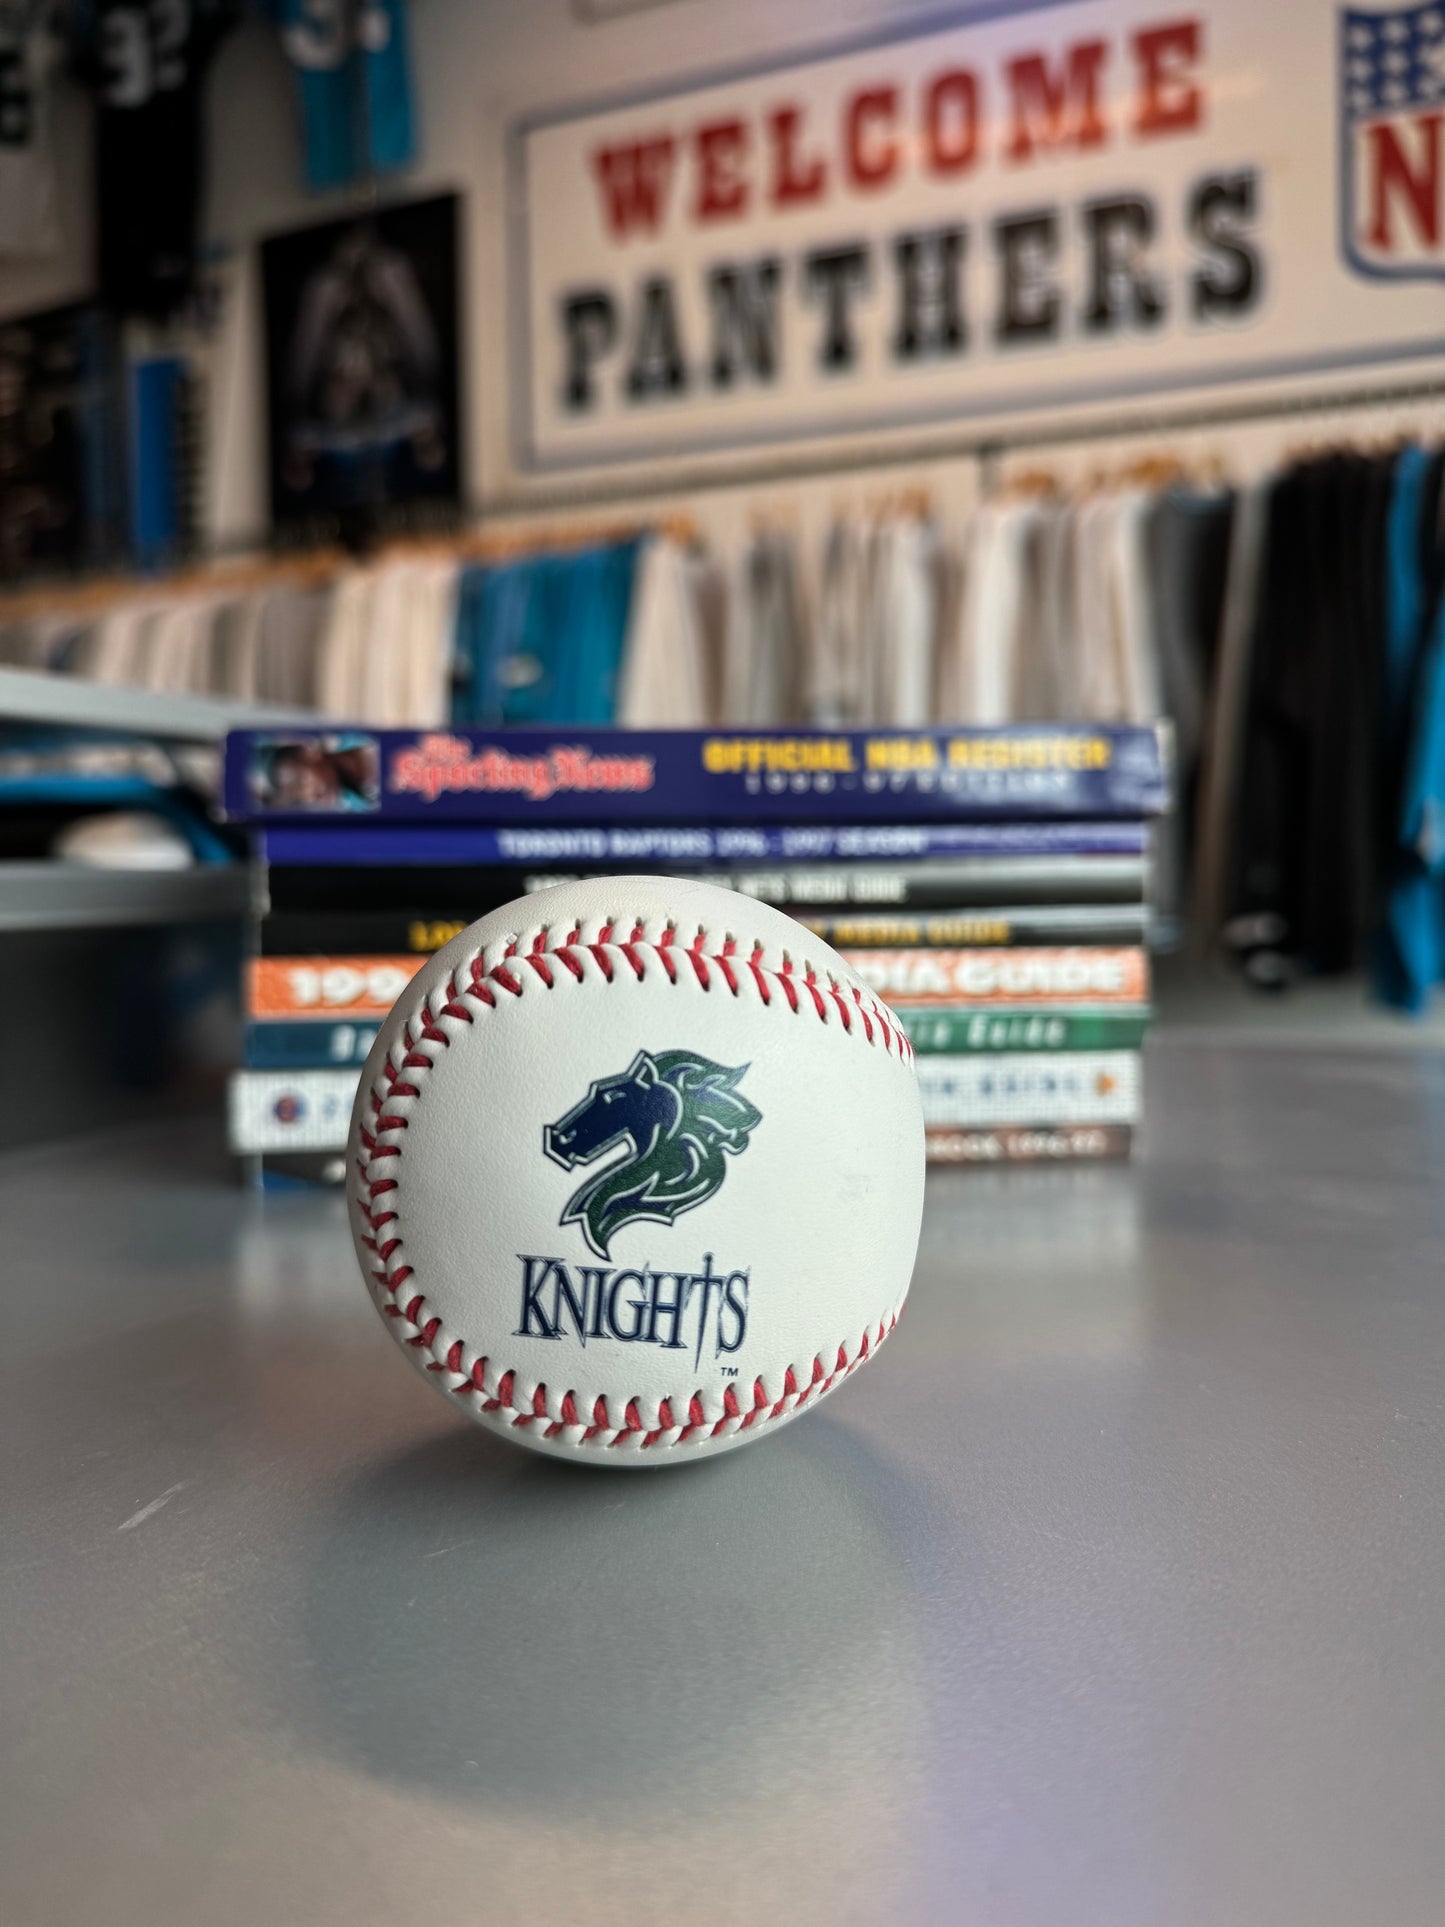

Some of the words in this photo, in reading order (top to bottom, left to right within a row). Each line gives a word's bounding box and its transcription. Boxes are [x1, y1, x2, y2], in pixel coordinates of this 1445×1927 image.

[590, 17, 1204, 248] WELCOME
[556, 162, 1264, 416] PANTHERS
[550, 744, 655, 792] News
[702, 738, 856, 773] OFFICIAL
[863, 738, 936, 771] NBA
[948, 736, 1110, 770] REGISTER
[609, 828, 713, 858] RAPTORS
[954, 955, 1124, 993] GUIDE
[511, 1252, 751, 1373] KNIGHTS
